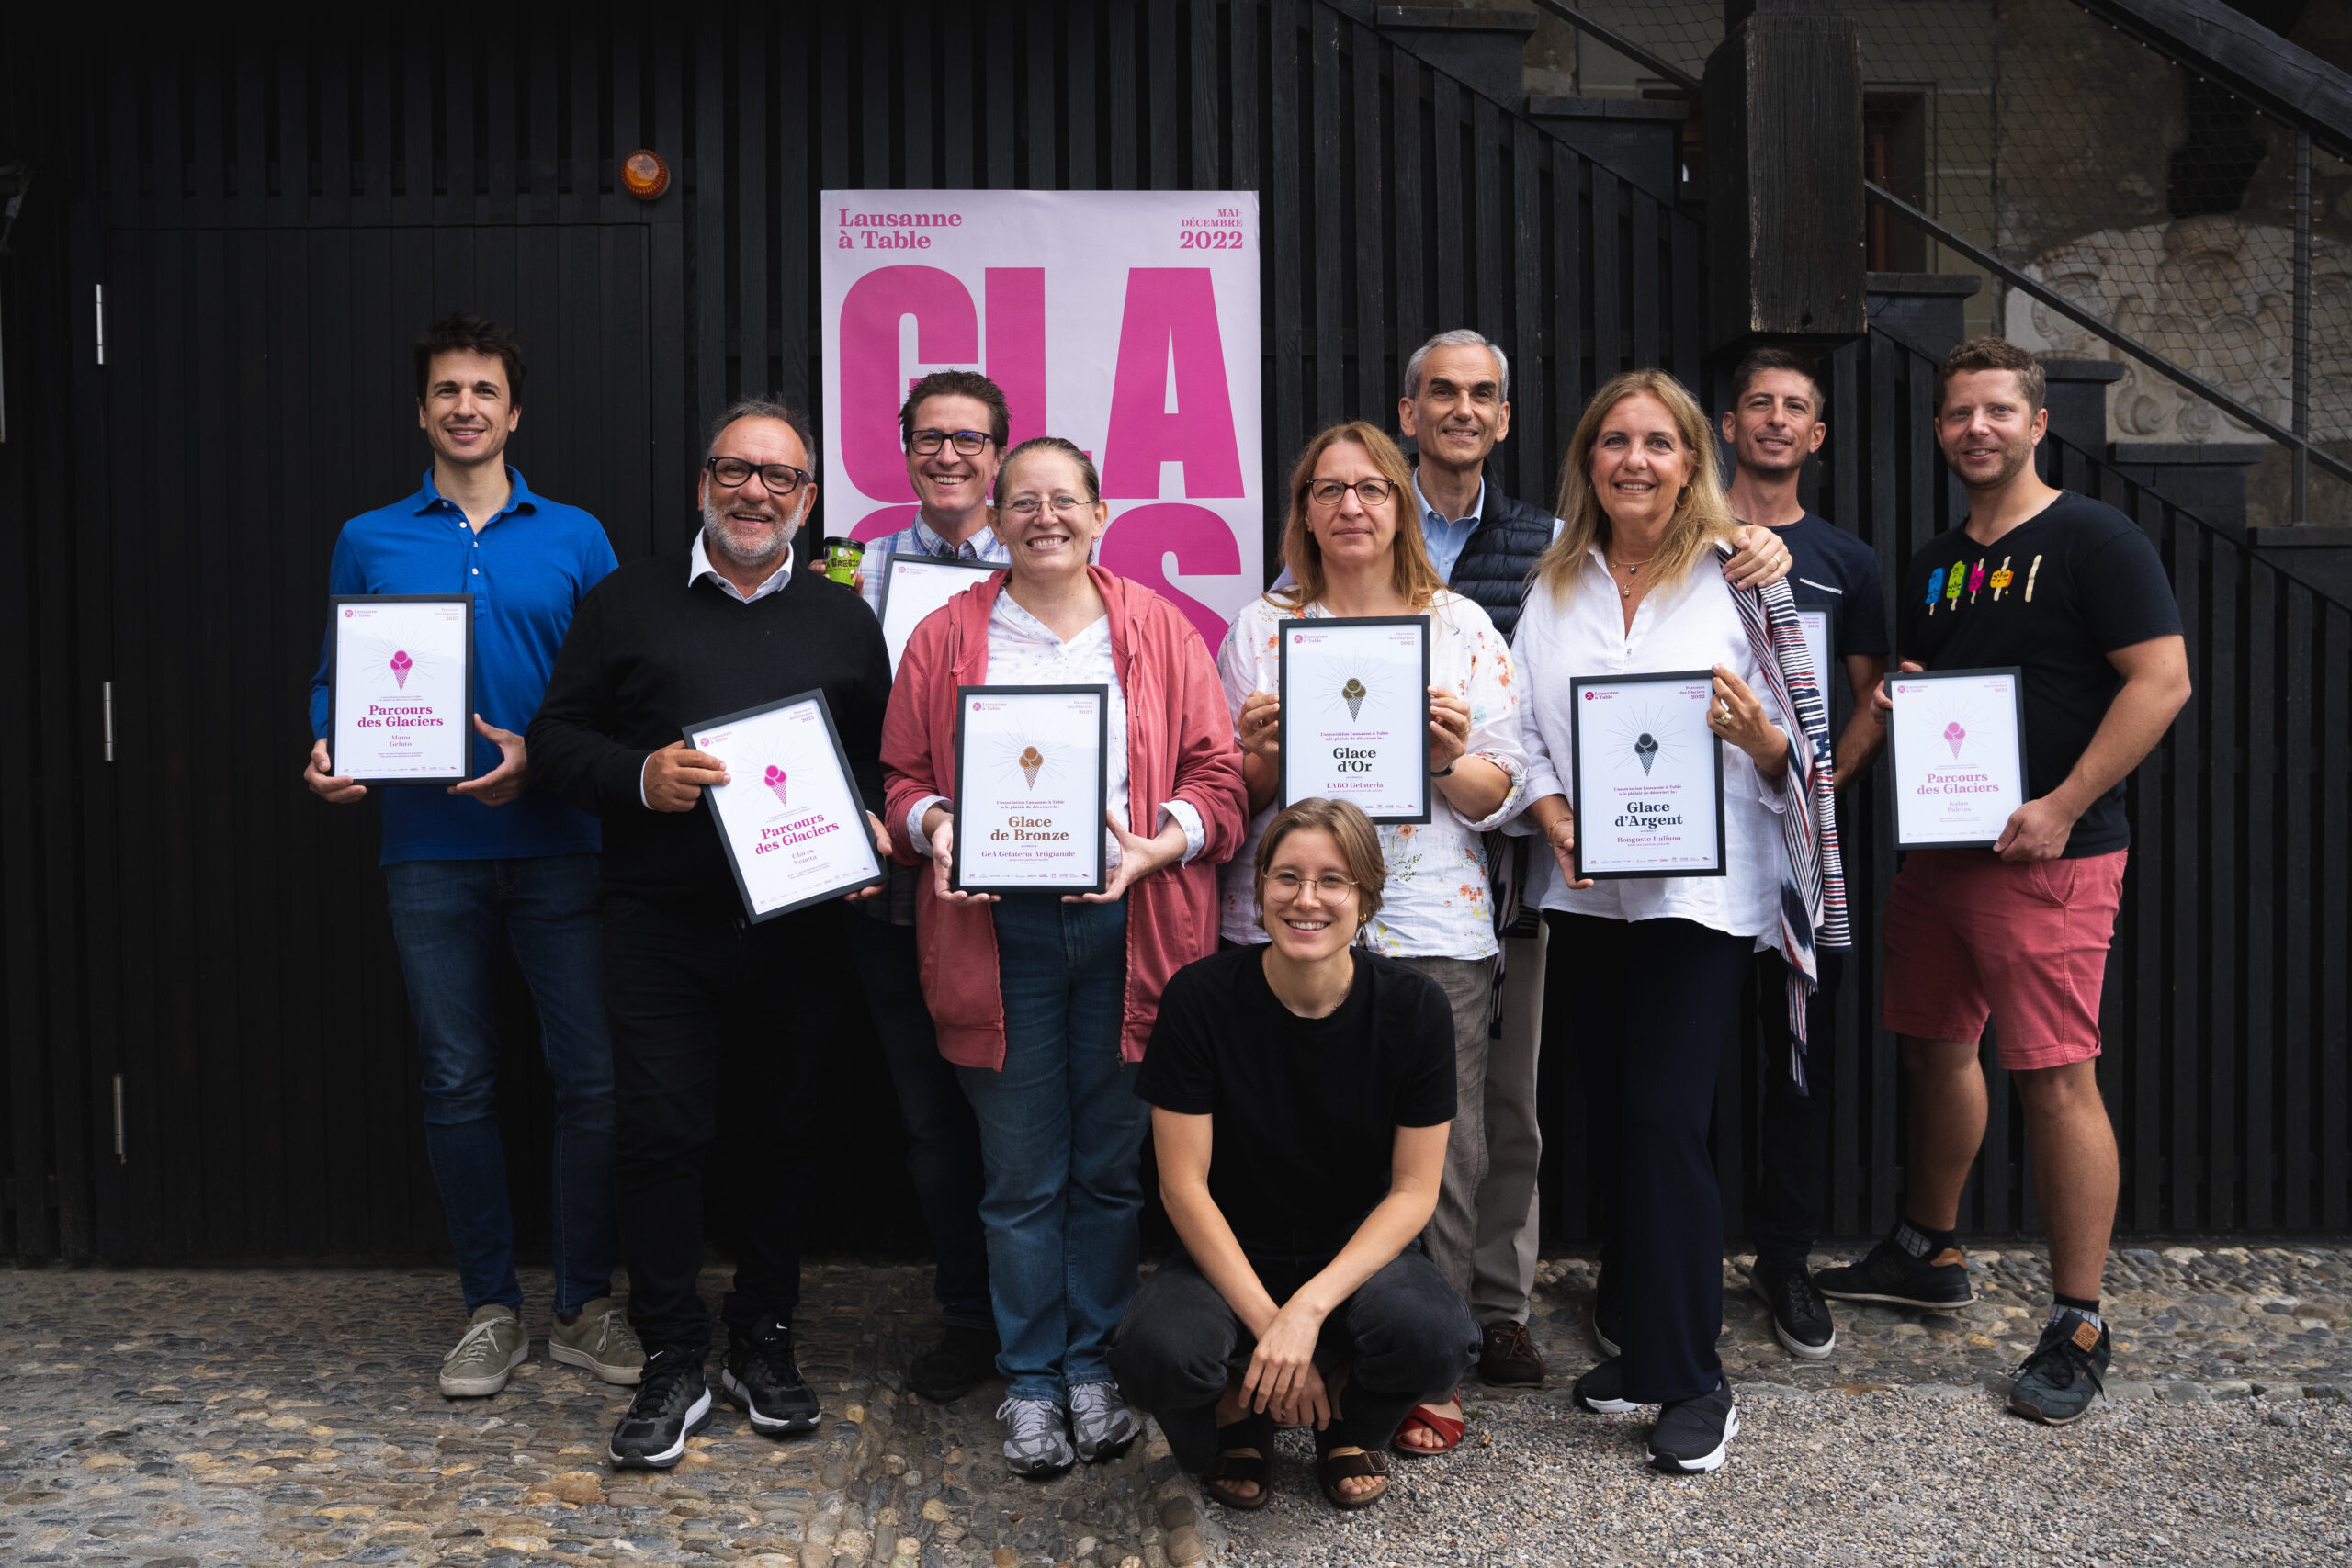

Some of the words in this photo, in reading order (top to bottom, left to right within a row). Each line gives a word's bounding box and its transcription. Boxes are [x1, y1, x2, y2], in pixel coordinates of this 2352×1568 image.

[838, 209, 963, 227] Lausanne
[1217, 209, 1243, 218] MAI-
[1181, 216, 1243, 228] DÉCEMBRE
[838, 230, 854, 249] à
[860, 230, 932, 250] Table
[1179, 231, 1243, 249] 2022
[368, 705, 433, 716] Parcours
[357, 716, 382, 728] des
[385, 716, 444, 728] Glaciers
[1333, 747, 1376, 759] Glace
[1337, 761, 1372, 773] d'Or
[1926, 773, 1988, 784] Parcours
[1917, 784, 1940, 795] des
[1943, 783, 2000, 794] Glaciers
[1626, 801, 1670, 814] Glace
[761, 813, 825, 840] Parcours
[1008, 816, 1052, 828] Glace
[1614, 813, 1684, 829] d'Argent
[754, 841, 780, 855] des
[782, 822, 840, 847] Glaciers
[990, 829, 1009, 840] de
[1013, 829, 1069, 840] Bronze
[1617, 836, 1652, 844] Bongusto
[1035, 850, 1076, 858] Artigianale
